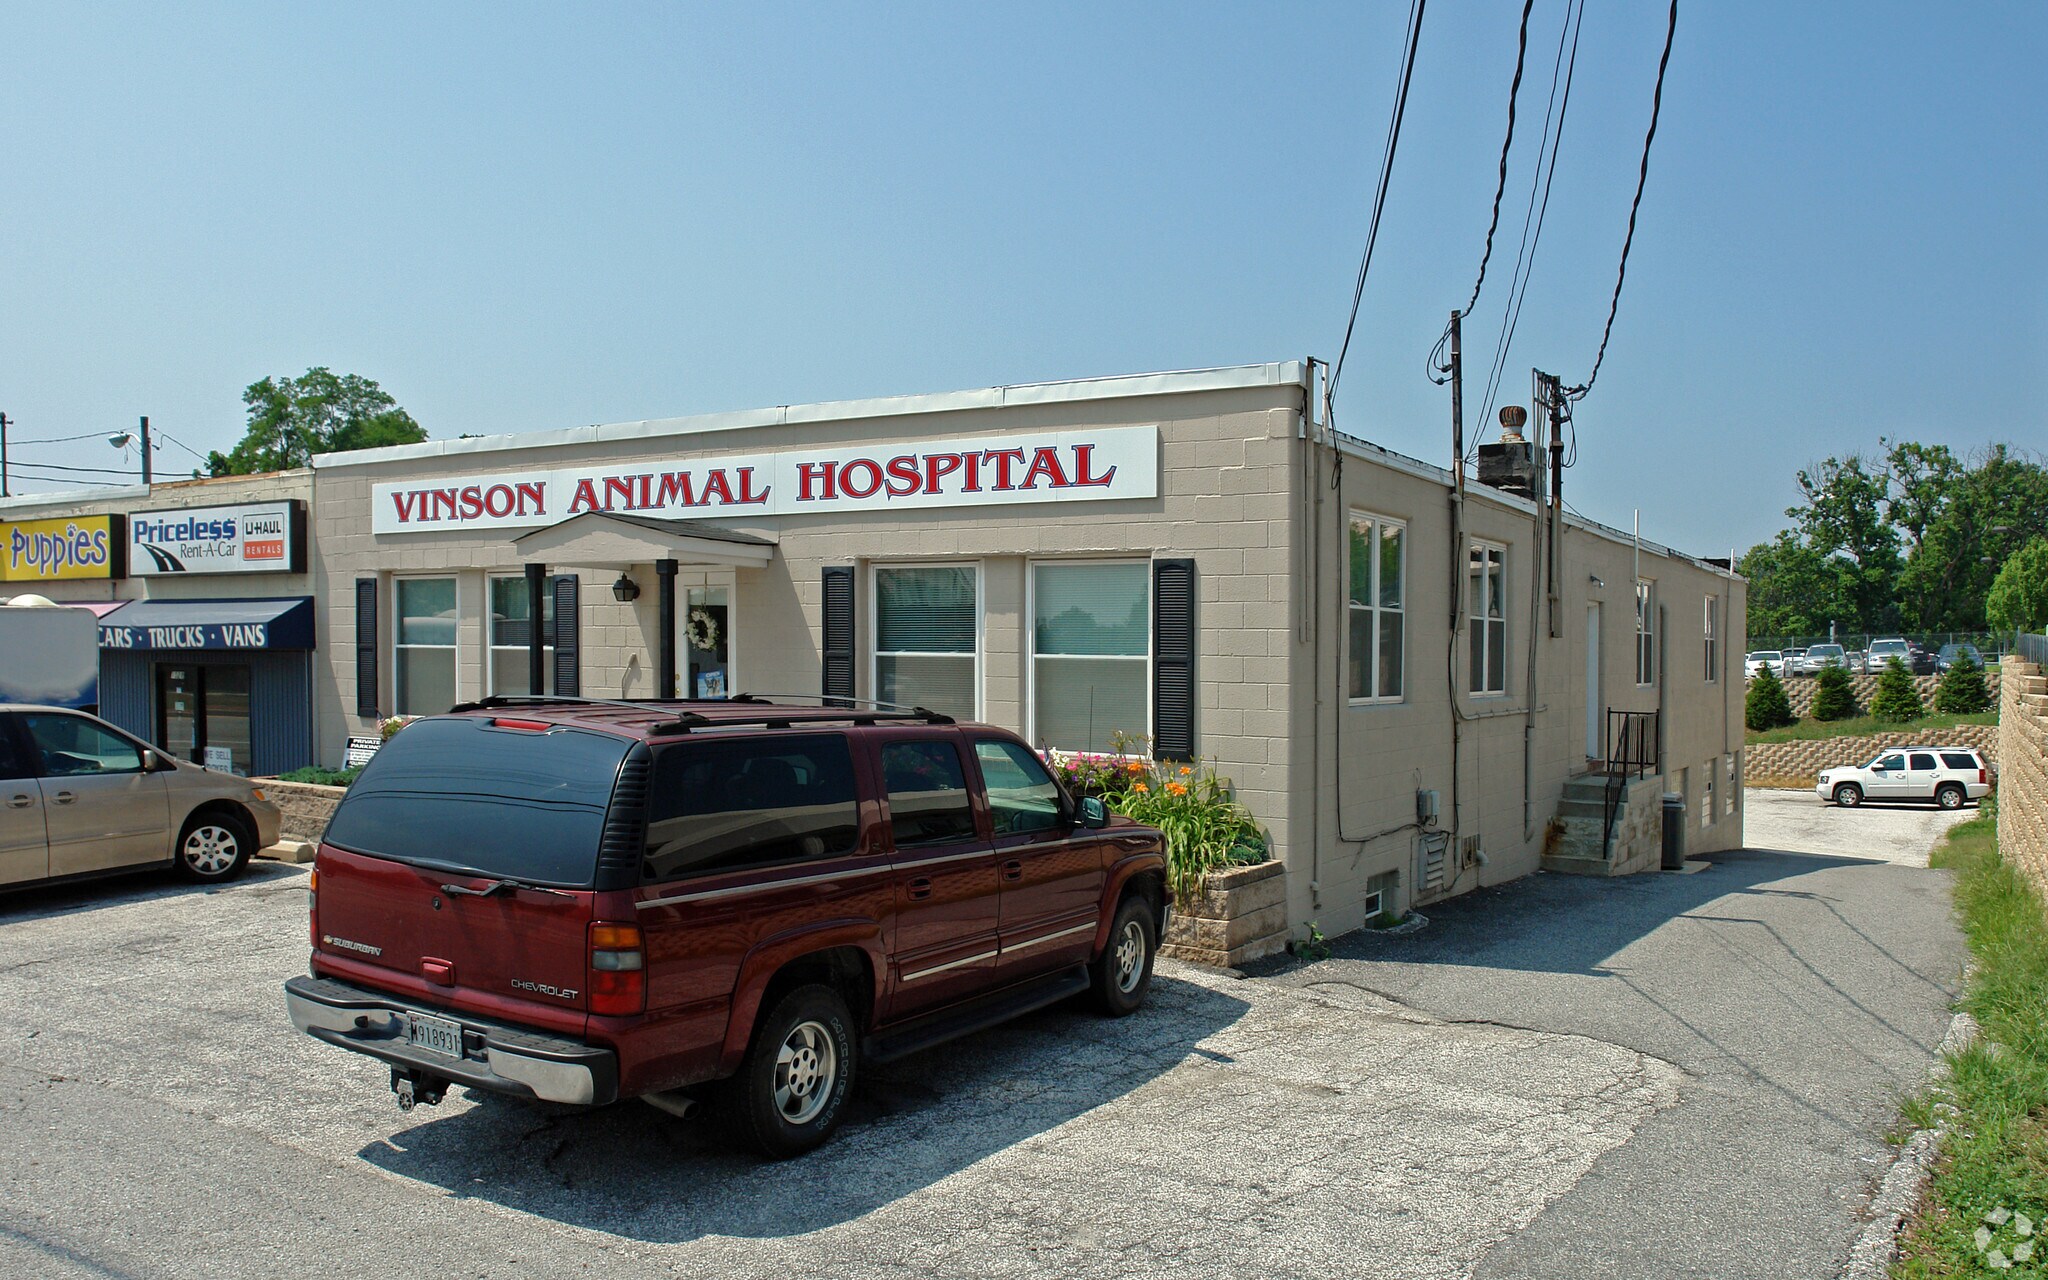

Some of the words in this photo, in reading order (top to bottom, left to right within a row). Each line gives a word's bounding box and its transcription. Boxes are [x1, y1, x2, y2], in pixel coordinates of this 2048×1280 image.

[391, 481, 546, 523] VINSON
[567, 467, 771, 513] ANIMAL
[796, 444, 1117, 501] HOSPITAL
[245, 521, 281, 535] U-HAUL
[180, 541, 237, 558] Rent-A-Car
[246, 545, 281, 555] RENTALS
[148, 626, 205, 648] TRUCKS
[221, 624, 265, 647] VANS
[333, 937, 382, 956] SUBURBAN
[511, 979, 579, 999] CHEVROLET
